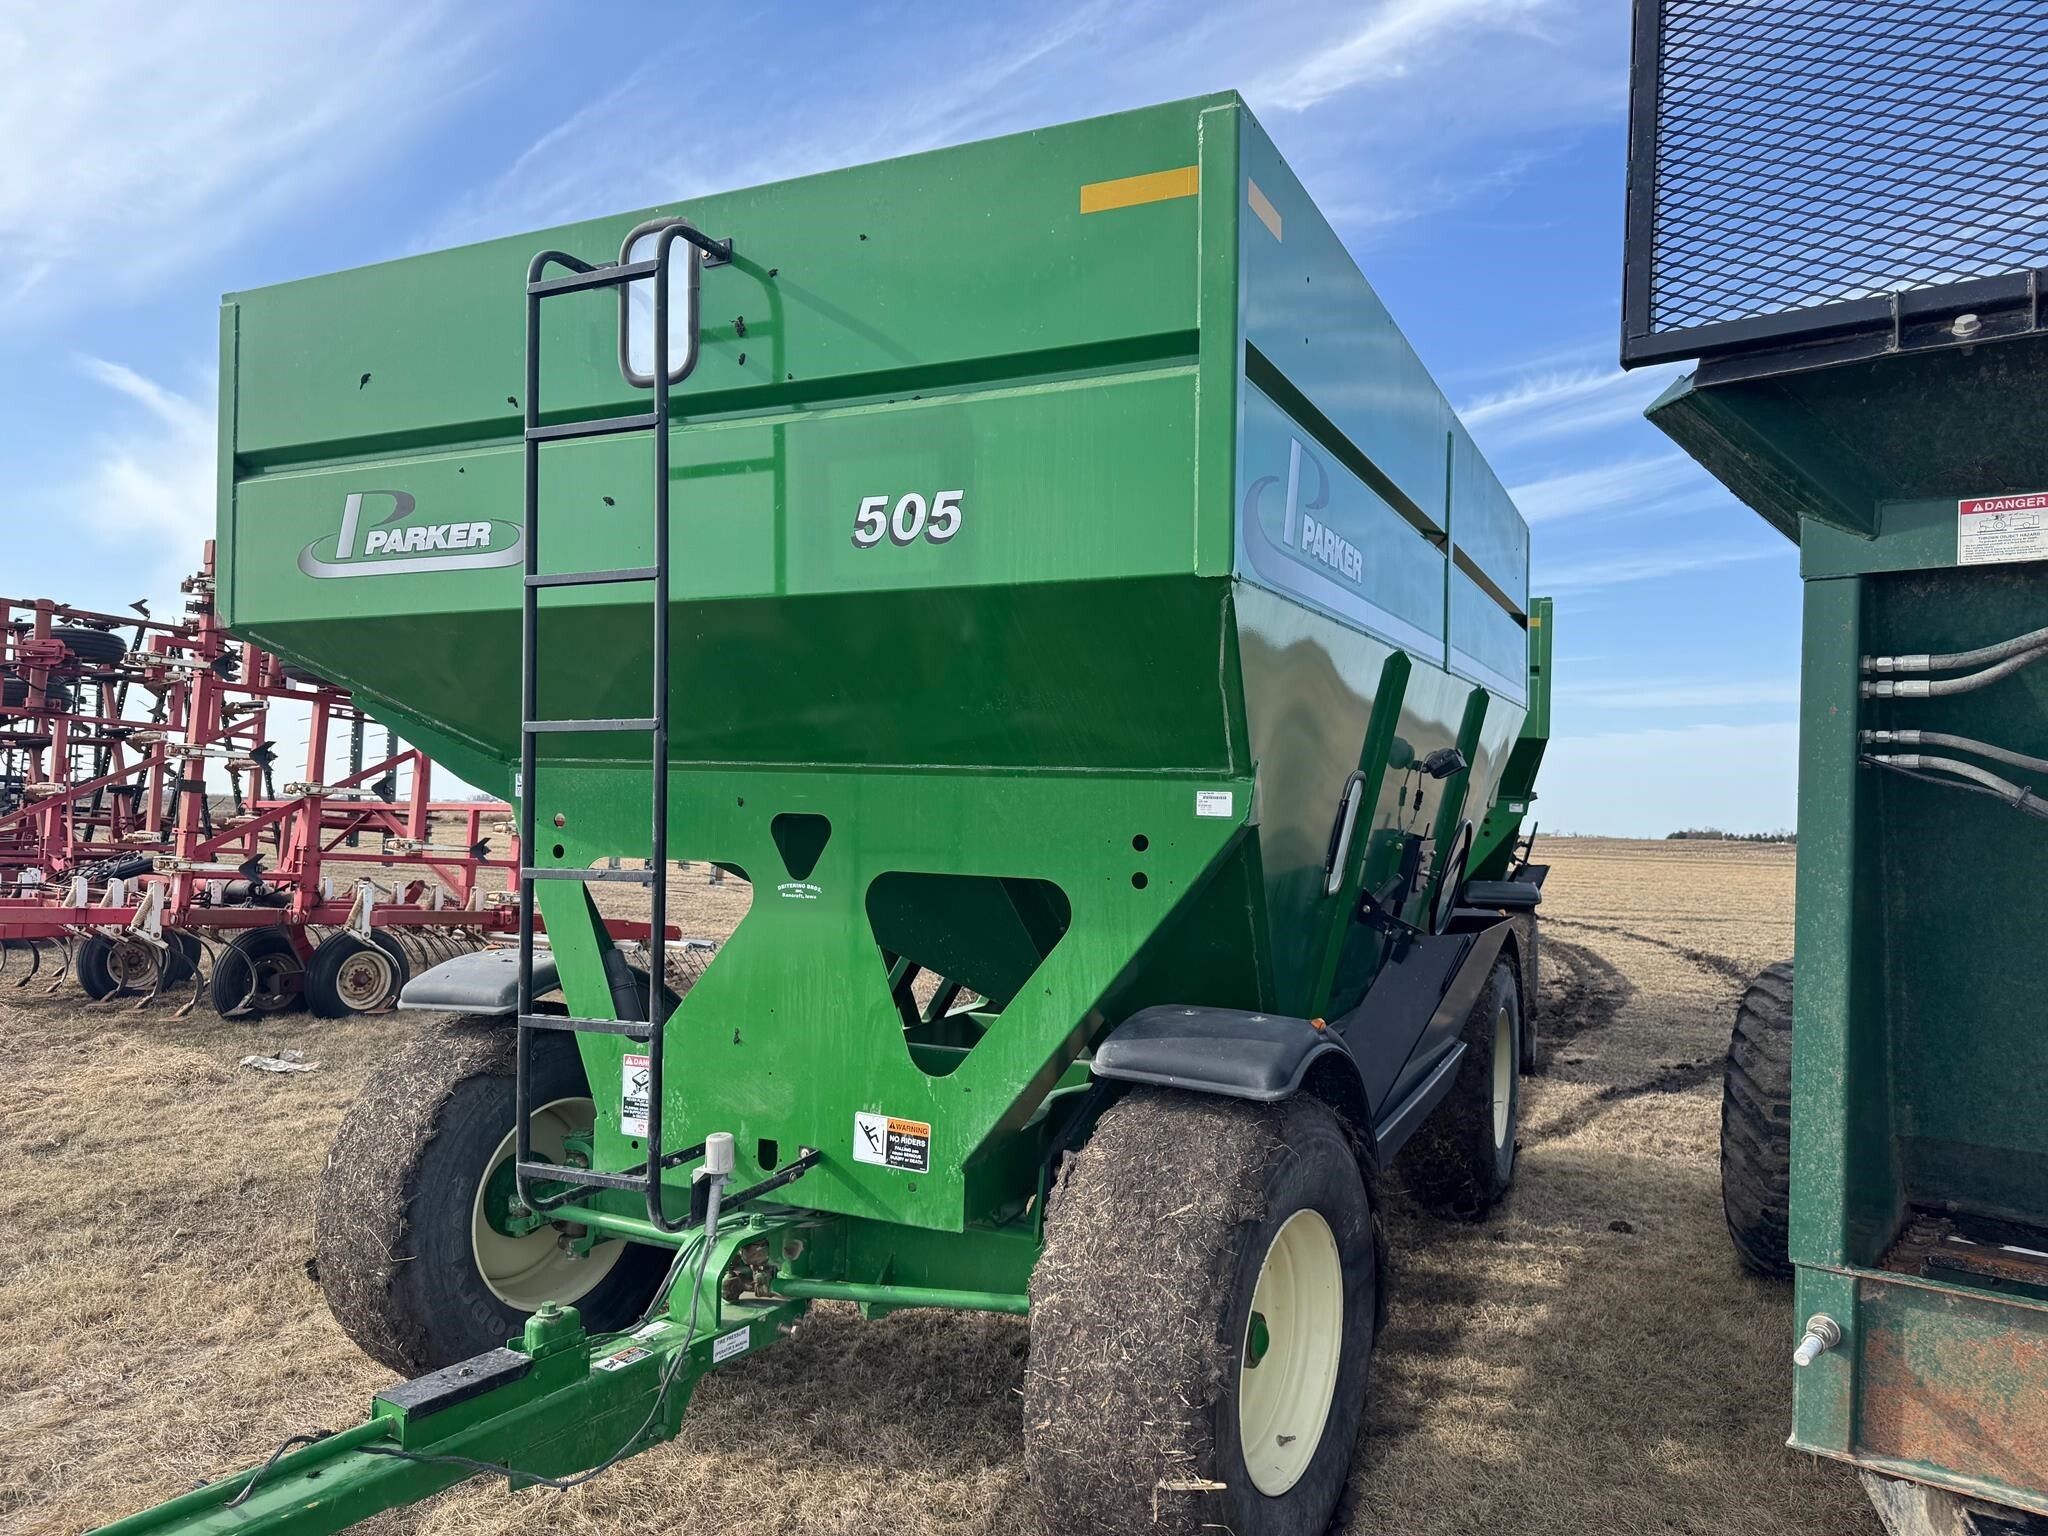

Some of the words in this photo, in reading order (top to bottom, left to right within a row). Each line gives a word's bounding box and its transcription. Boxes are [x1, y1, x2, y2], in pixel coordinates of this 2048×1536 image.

[1984, 496, 2046, 511] DANGER
[851, 489, 964, 549] 505
[363, 521, 493, 556] PARKER
[1301, 513, 1364, 584] PARKER
[633, 1058, 649, 1068] DAN
[896, 1123, 928, 1135] WARNING
[901, 1136, 926, 1147] RIDERS
